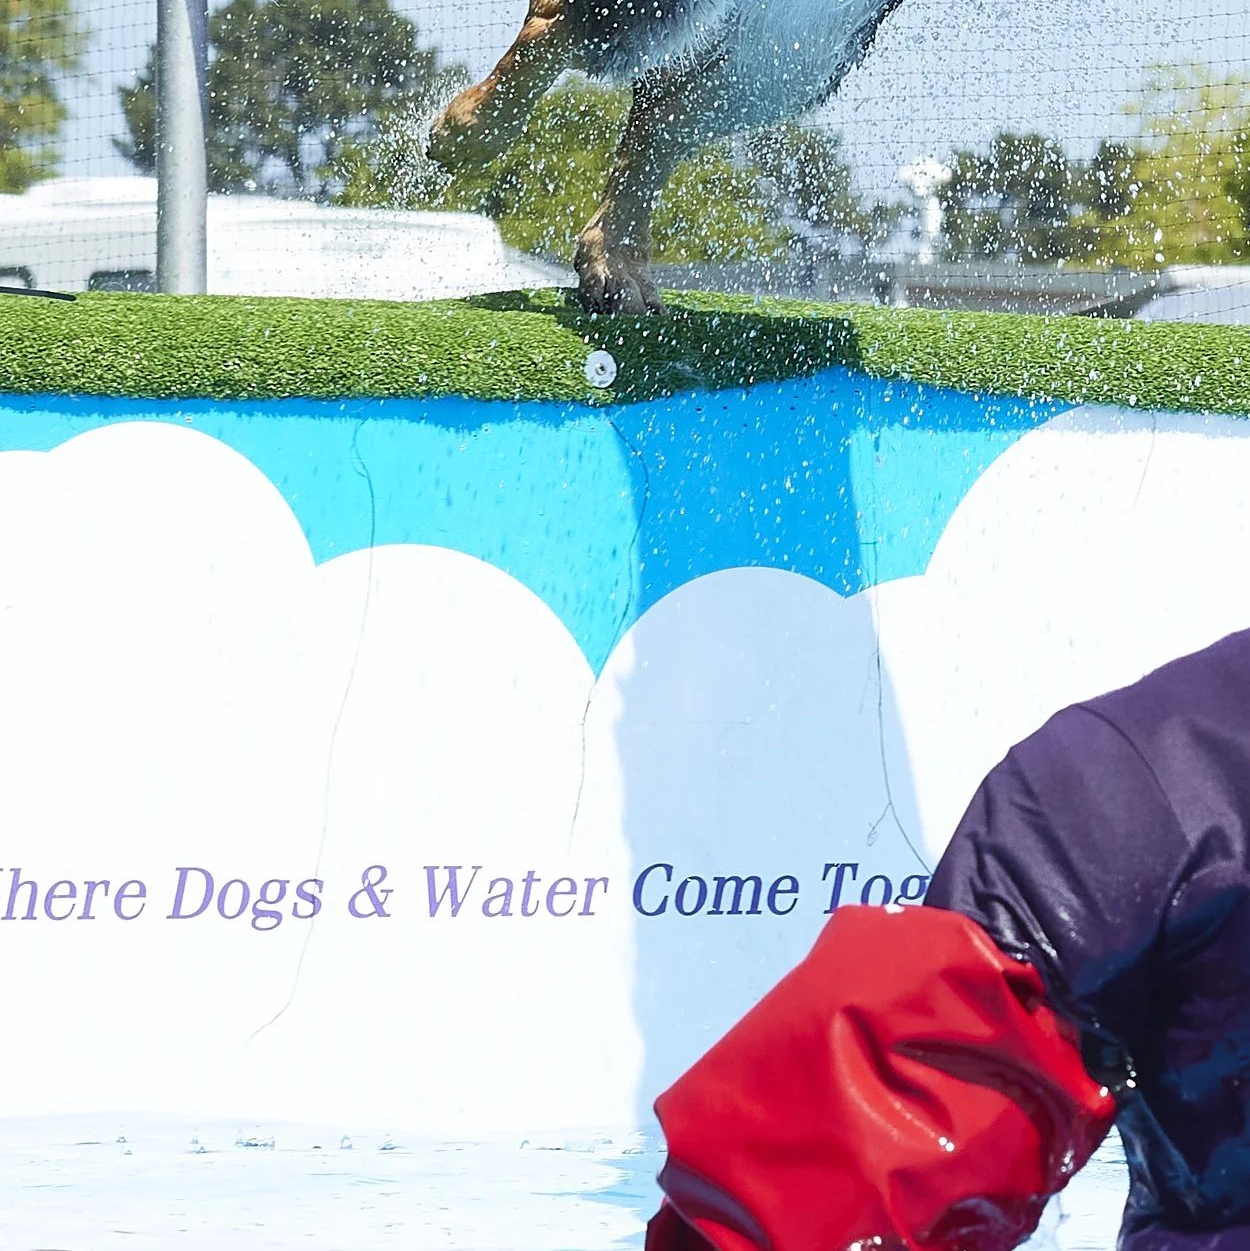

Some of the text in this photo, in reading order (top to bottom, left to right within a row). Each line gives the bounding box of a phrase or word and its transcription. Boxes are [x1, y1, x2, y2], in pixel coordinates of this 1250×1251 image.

[0, 862, 930, 931] here Dogs & Water Come Tog
